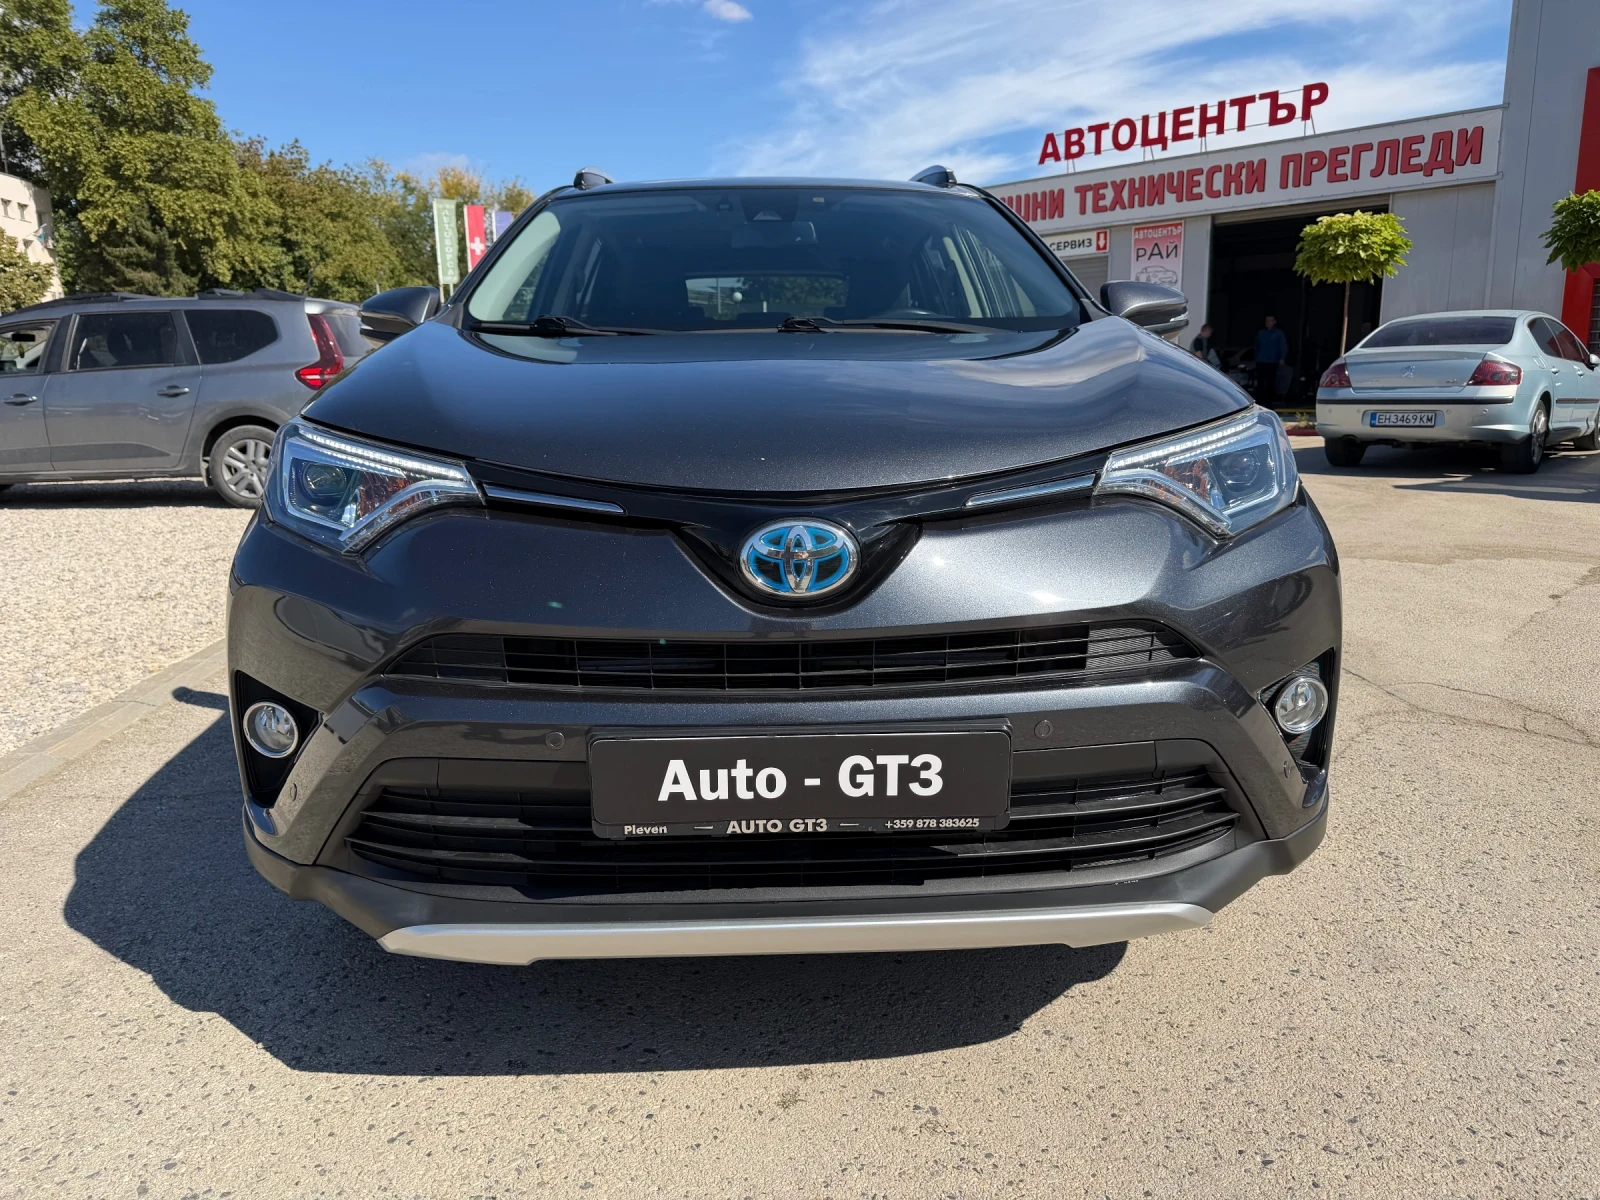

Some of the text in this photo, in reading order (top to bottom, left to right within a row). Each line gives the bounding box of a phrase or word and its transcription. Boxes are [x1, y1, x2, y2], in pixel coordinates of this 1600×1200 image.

[1038, 82, 1330, 166] АВТОЦЕНТЪР
[1000, 125, 1485, 223] ШНИ ТЕХНИЧЕСКИ ПРЕГЛЕДИ
[1134, 226, 1182, 239] АВТОЦЕНТЪР
[1049, 238, 1092, 252] СЕРВИЗ
[1136, 240, 1178, 262] РАЙ
[657, 759, 787, 801] Auto
[838, 754, 944, 797] GT3
[623, 825, 668, 835] Pleven
[726, 819, 828, 834] AUTO GT3
[884, 818, 980, 829] +359 878 383625
